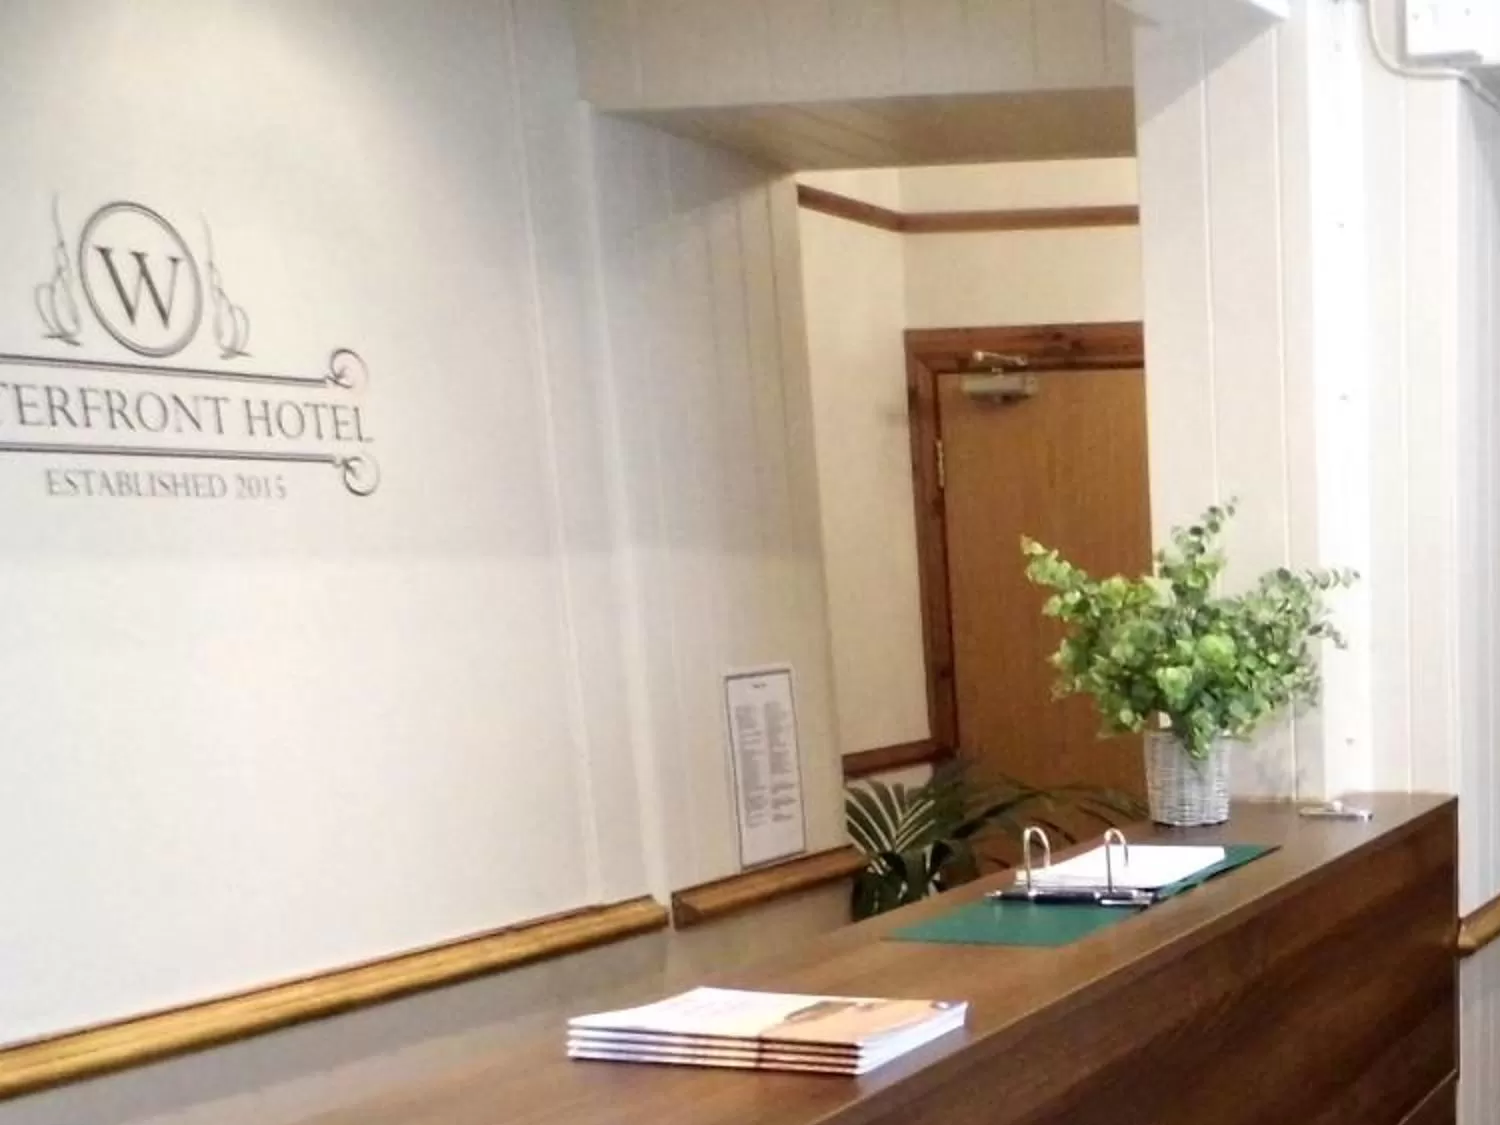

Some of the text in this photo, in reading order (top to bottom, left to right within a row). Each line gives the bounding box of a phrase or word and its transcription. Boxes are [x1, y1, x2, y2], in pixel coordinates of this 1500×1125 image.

[96, 245, 183, 329] W
[0, 382, 375, 443] ERFRONT HOTEL
[44, 467, 288, 500] ESTABLISHED 2015
